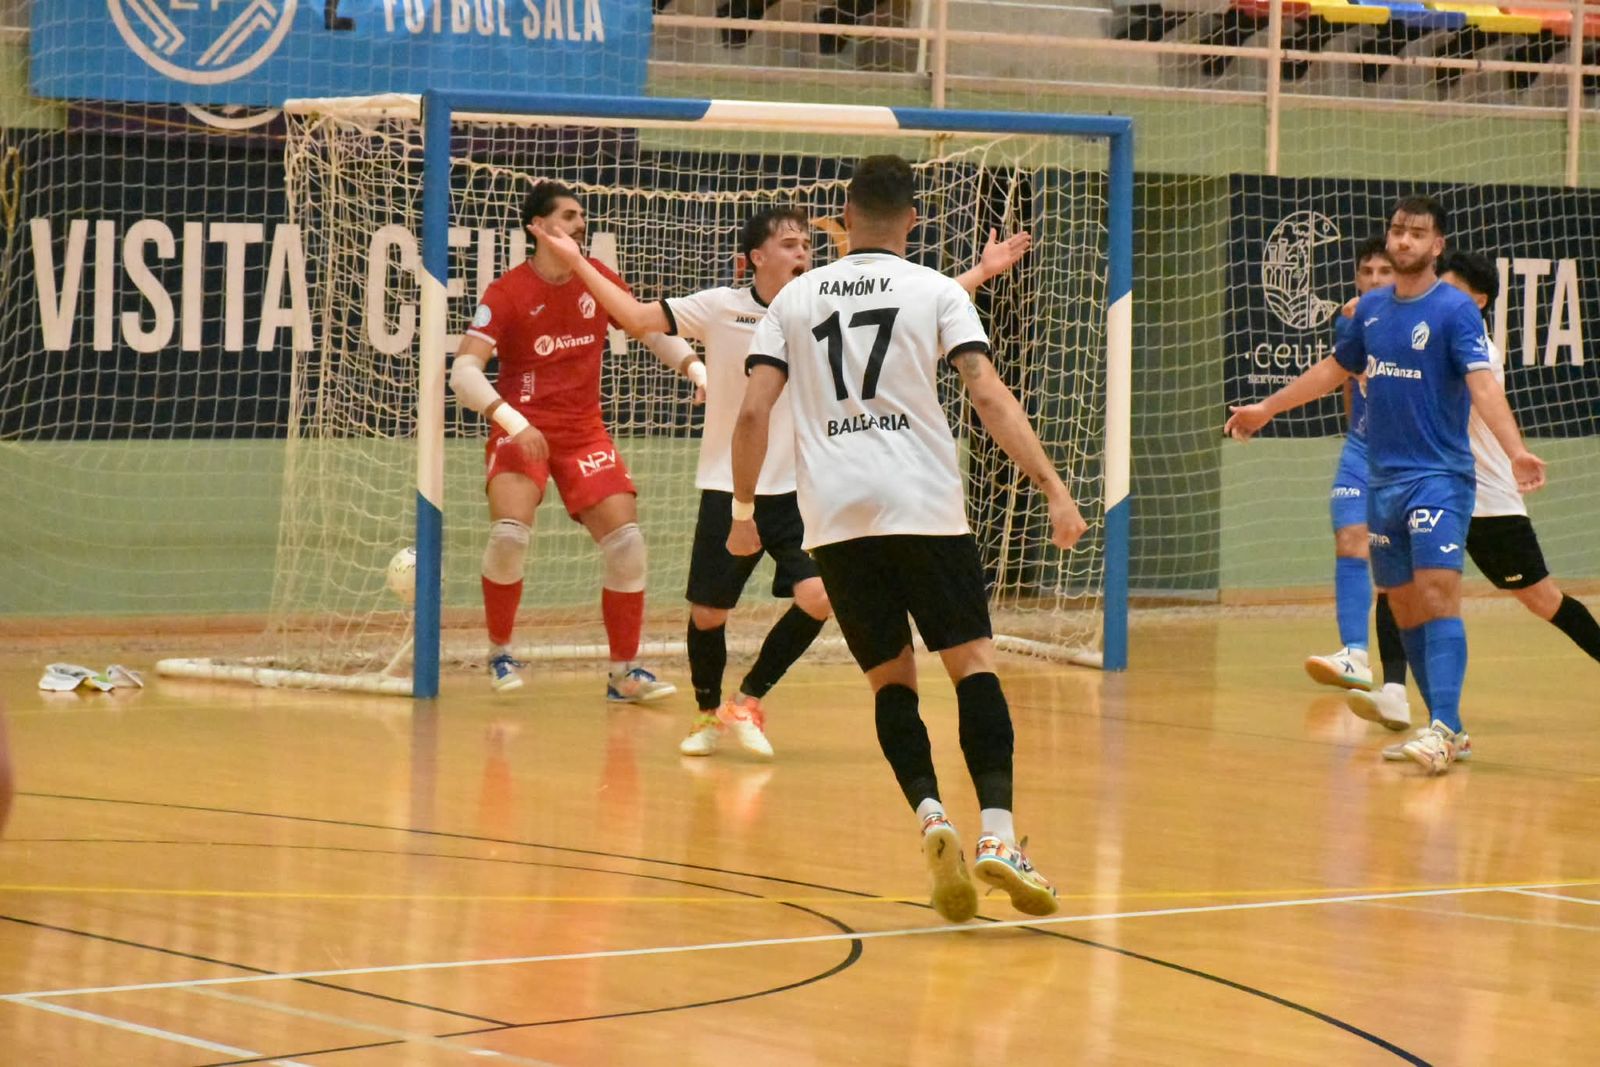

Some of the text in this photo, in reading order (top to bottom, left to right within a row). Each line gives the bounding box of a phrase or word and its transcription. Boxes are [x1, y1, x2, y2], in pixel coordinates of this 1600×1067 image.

[522, 0, 605, 42] SALA
[31, 218, 314, 352] VISITA
[819, 275, 893, 297] RAMÓN V.
[736, 316, 756, 324] JAKO
[555, 334, 595, 350] Avanza
[812, 307, 900, 401] 17
[1255, 338, 1328, 369] ceut
[1376, 361, 1422, 379] Avanza
